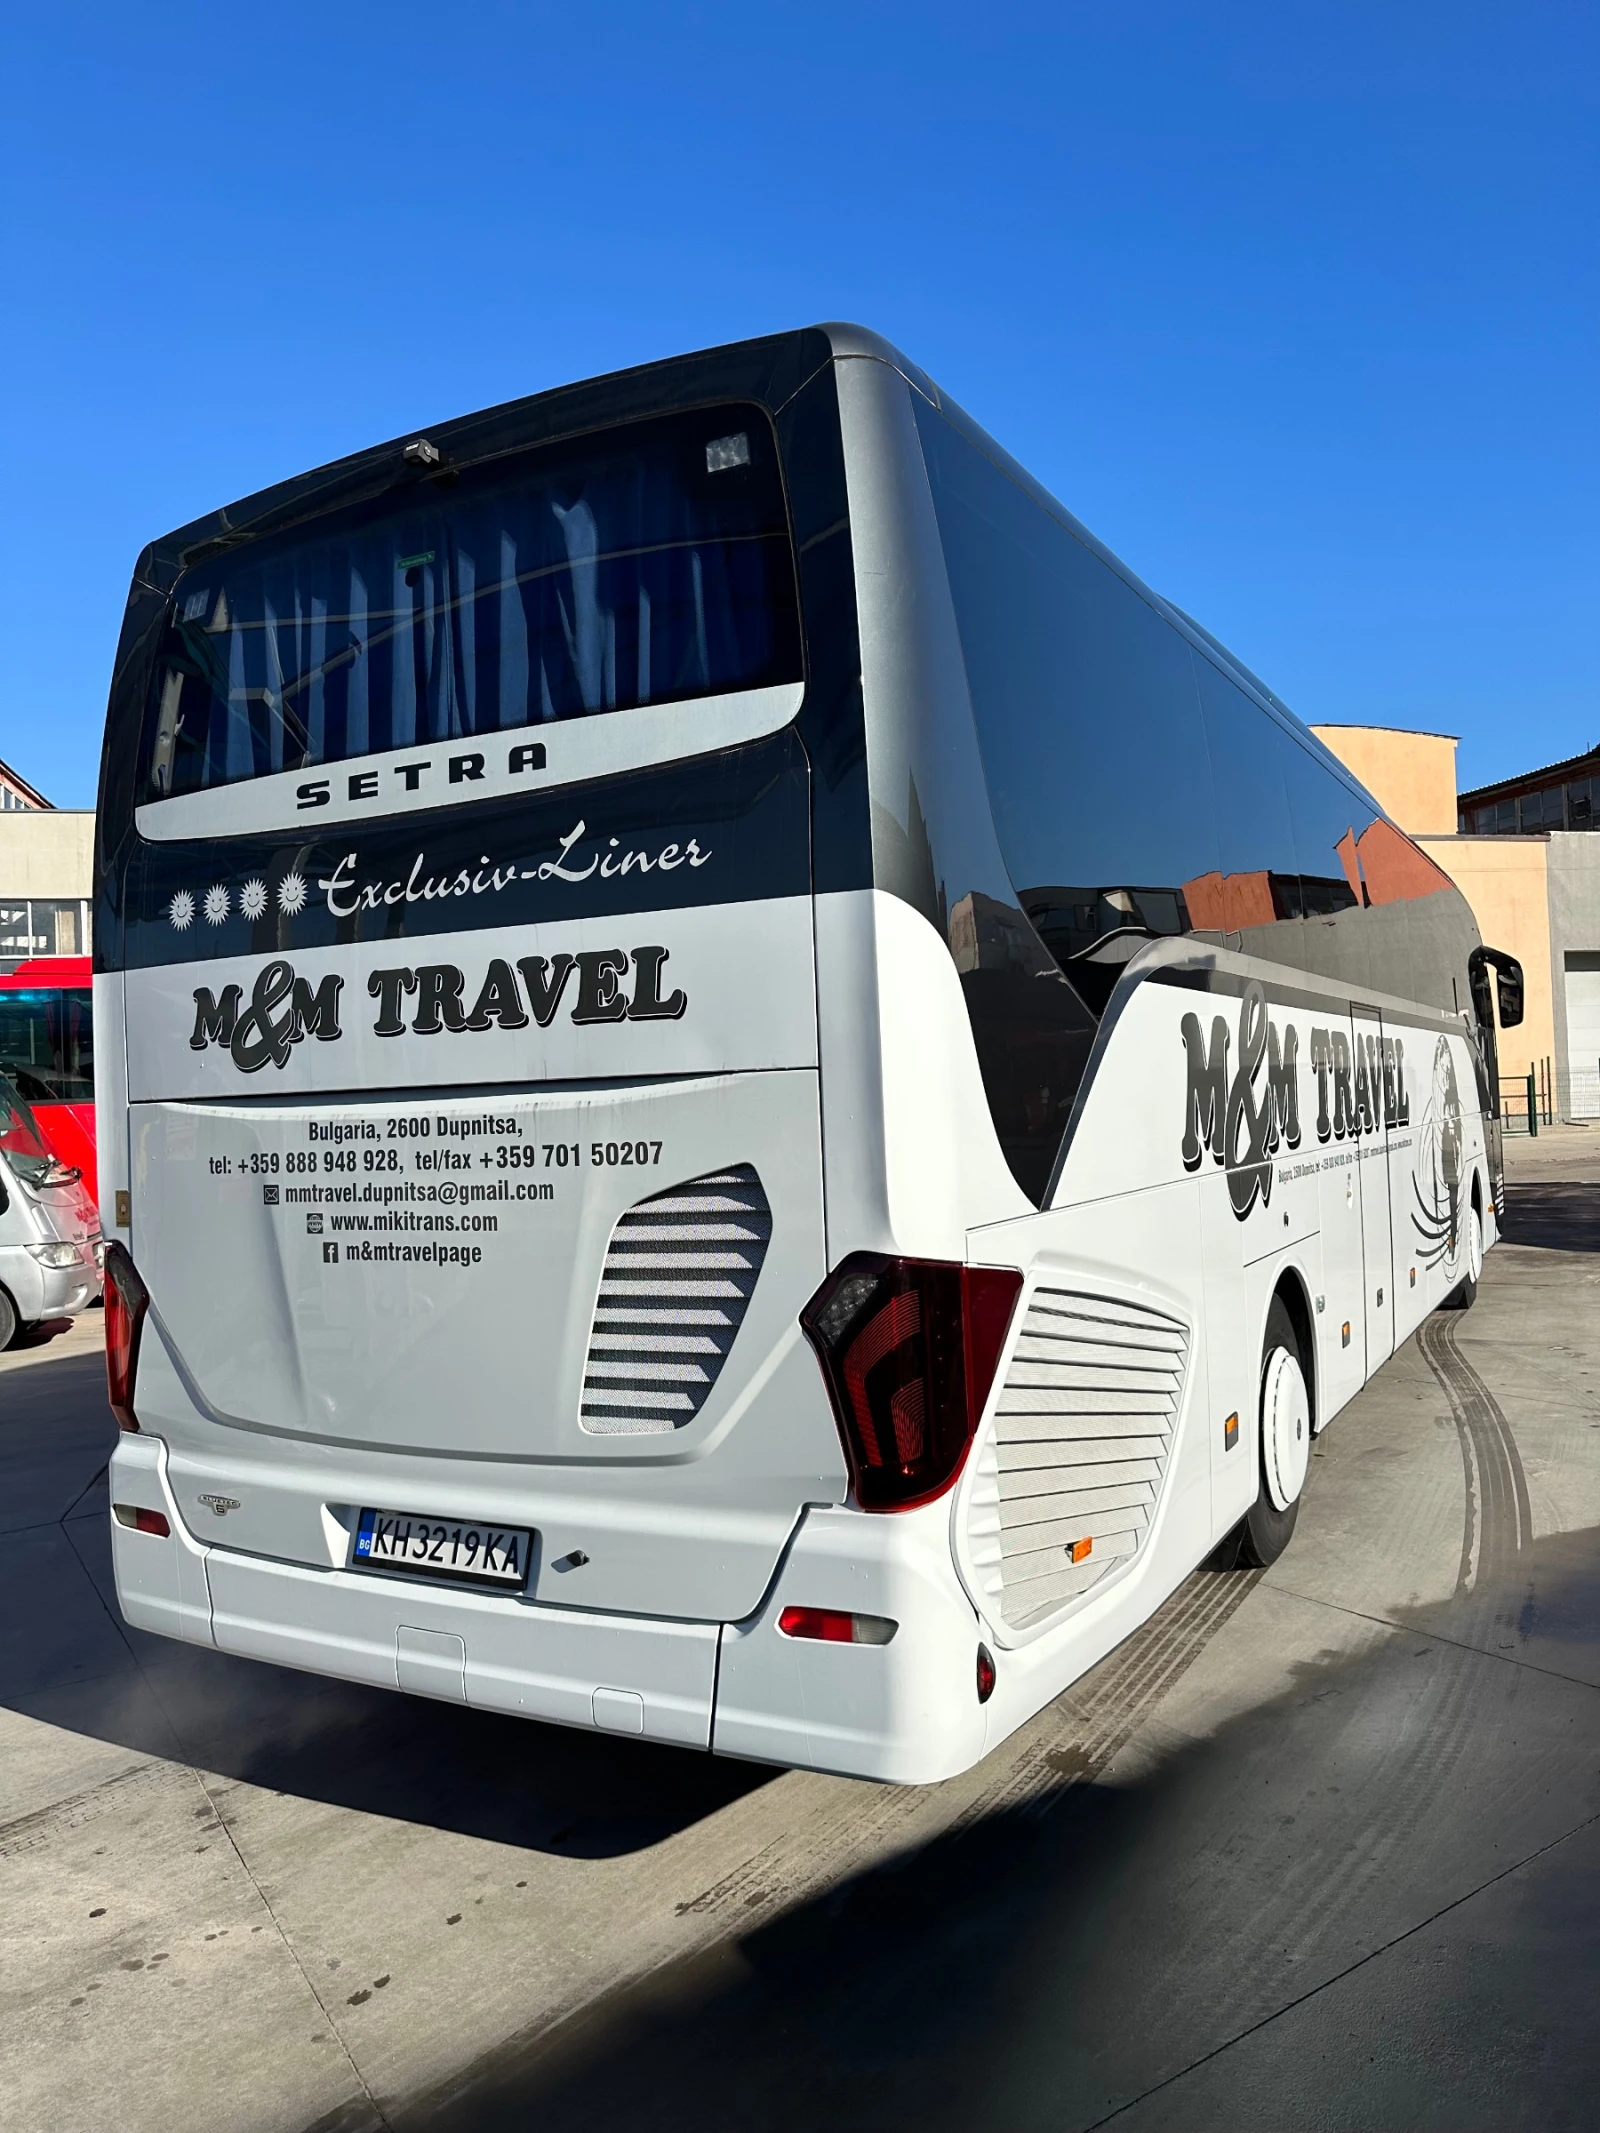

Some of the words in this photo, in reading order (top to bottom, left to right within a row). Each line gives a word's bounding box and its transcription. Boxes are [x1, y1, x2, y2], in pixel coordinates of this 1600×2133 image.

[296, 742, 547, 810] SETRA
[318, 819, 713, 918] Exclusiv-Liner
[190, 960, 345, 1074] M&M
[367, 945, 688, 1037] TRAVEL
[1180, 980, 1301, 1222] M&M
[1310, 1026, 1410, 1144] TRAVEL
[309, 1120, 382, 1144] Bulgaria,
[387, 1117, 431, 1139] 2600
[437, 1114, 523, 1140] Dupnitsa,
[209, 1156, 232, 1174] tel:
[238, 1152, 280, 1174] +359
[286, 1152, 318, 1173] 888
[324, 1150, 357, 1172] 948
[363, 1149, 404, 1174] 928,
[415, 1149, 471, 1172] tel/fax
[480, 1145, 535, 1168] +359
[542, 1143, 580, 1167] 701
[591, 1141, 663, 1166] 50207
[285, 1180, 554, 1206] mmtravel.dupnitsa@gmail.com
[331, 1211, 498, 1231] www.mikitrans.com
[346, 1241, 482, 1266] m&mtravelpage
[359, 1539, 371, 1550] BG
